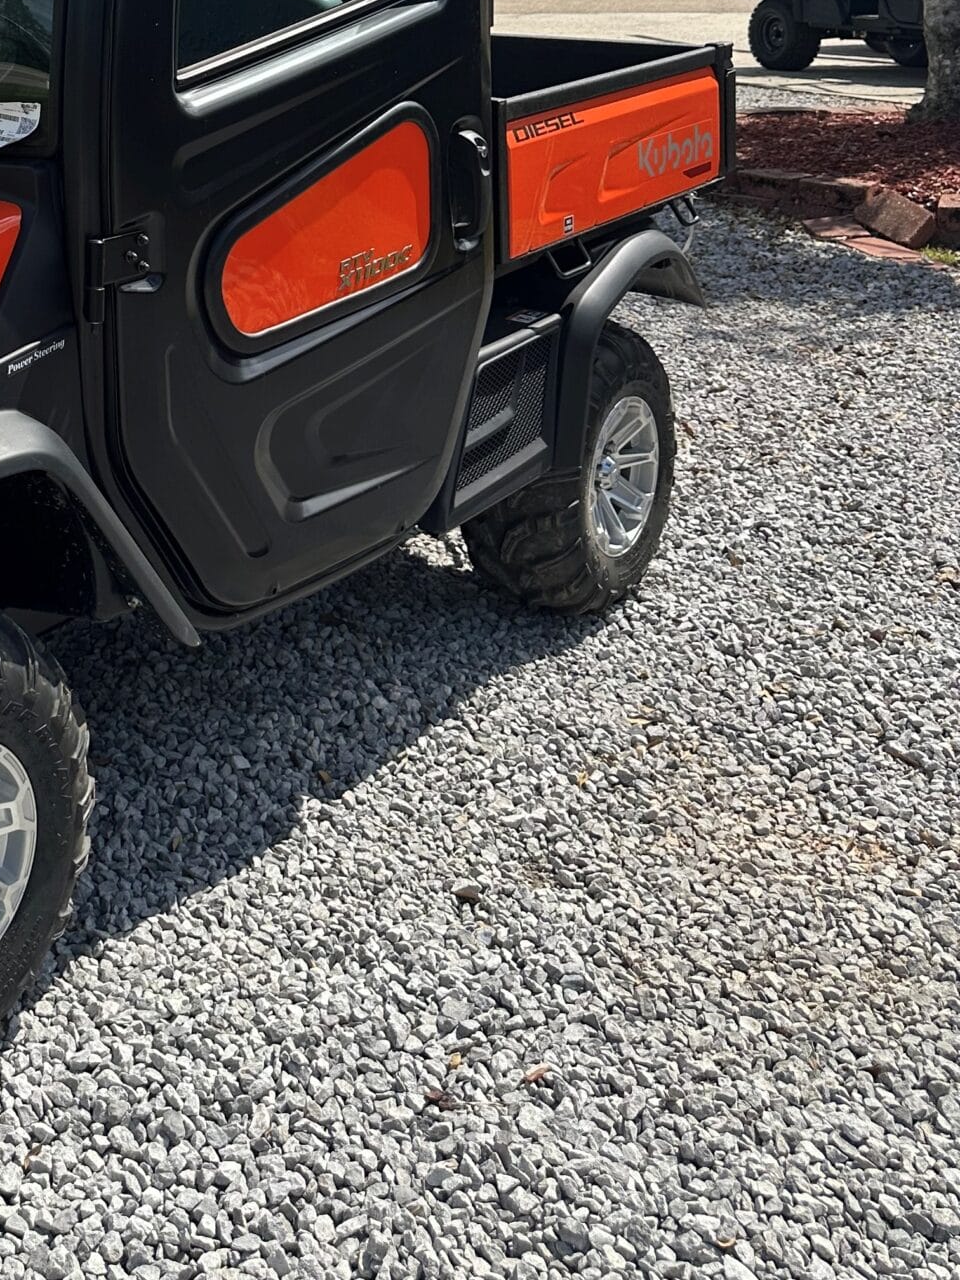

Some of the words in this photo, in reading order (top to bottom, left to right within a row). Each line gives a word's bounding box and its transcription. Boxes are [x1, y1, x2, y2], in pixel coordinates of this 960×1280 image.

[511, 111, 585, 144] DIESEL
[637, 125, 713, 177] Kubota
[339, 247, 376, 275] RTV
[7, 354, 33, 375] Power
[33, 338, 66, 361] Steering
